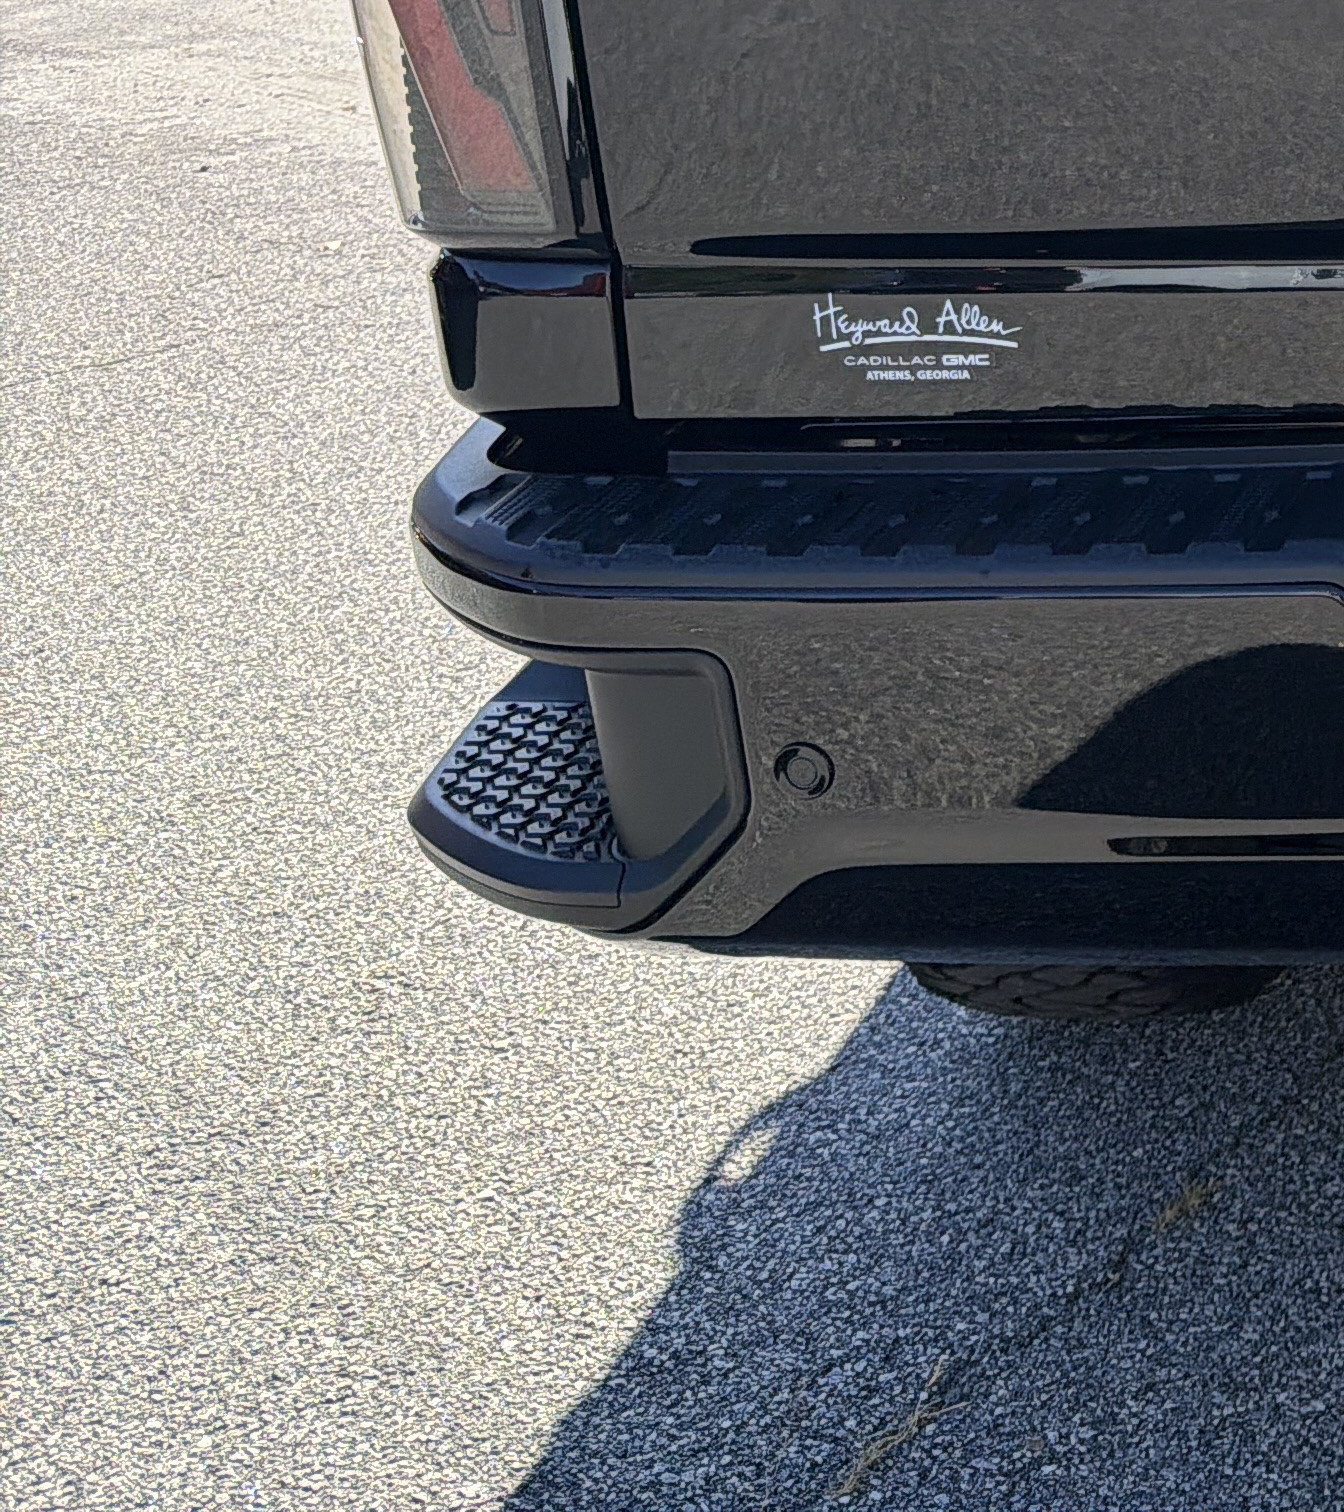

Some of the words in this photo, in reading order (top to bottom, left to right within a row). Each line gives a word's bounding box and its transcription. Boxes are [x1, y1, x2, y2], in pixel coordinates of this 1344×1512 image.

[813, 292, 921, 345] Heyward
[935, 298, 1023, 335] Allen
[843, 355, 936, 366] CADILLAC
[941, 354, 990, 366] GMC
[866, 370, 915, 381] ATHENS,
[917, 370, 971, 380] GEORGIA
